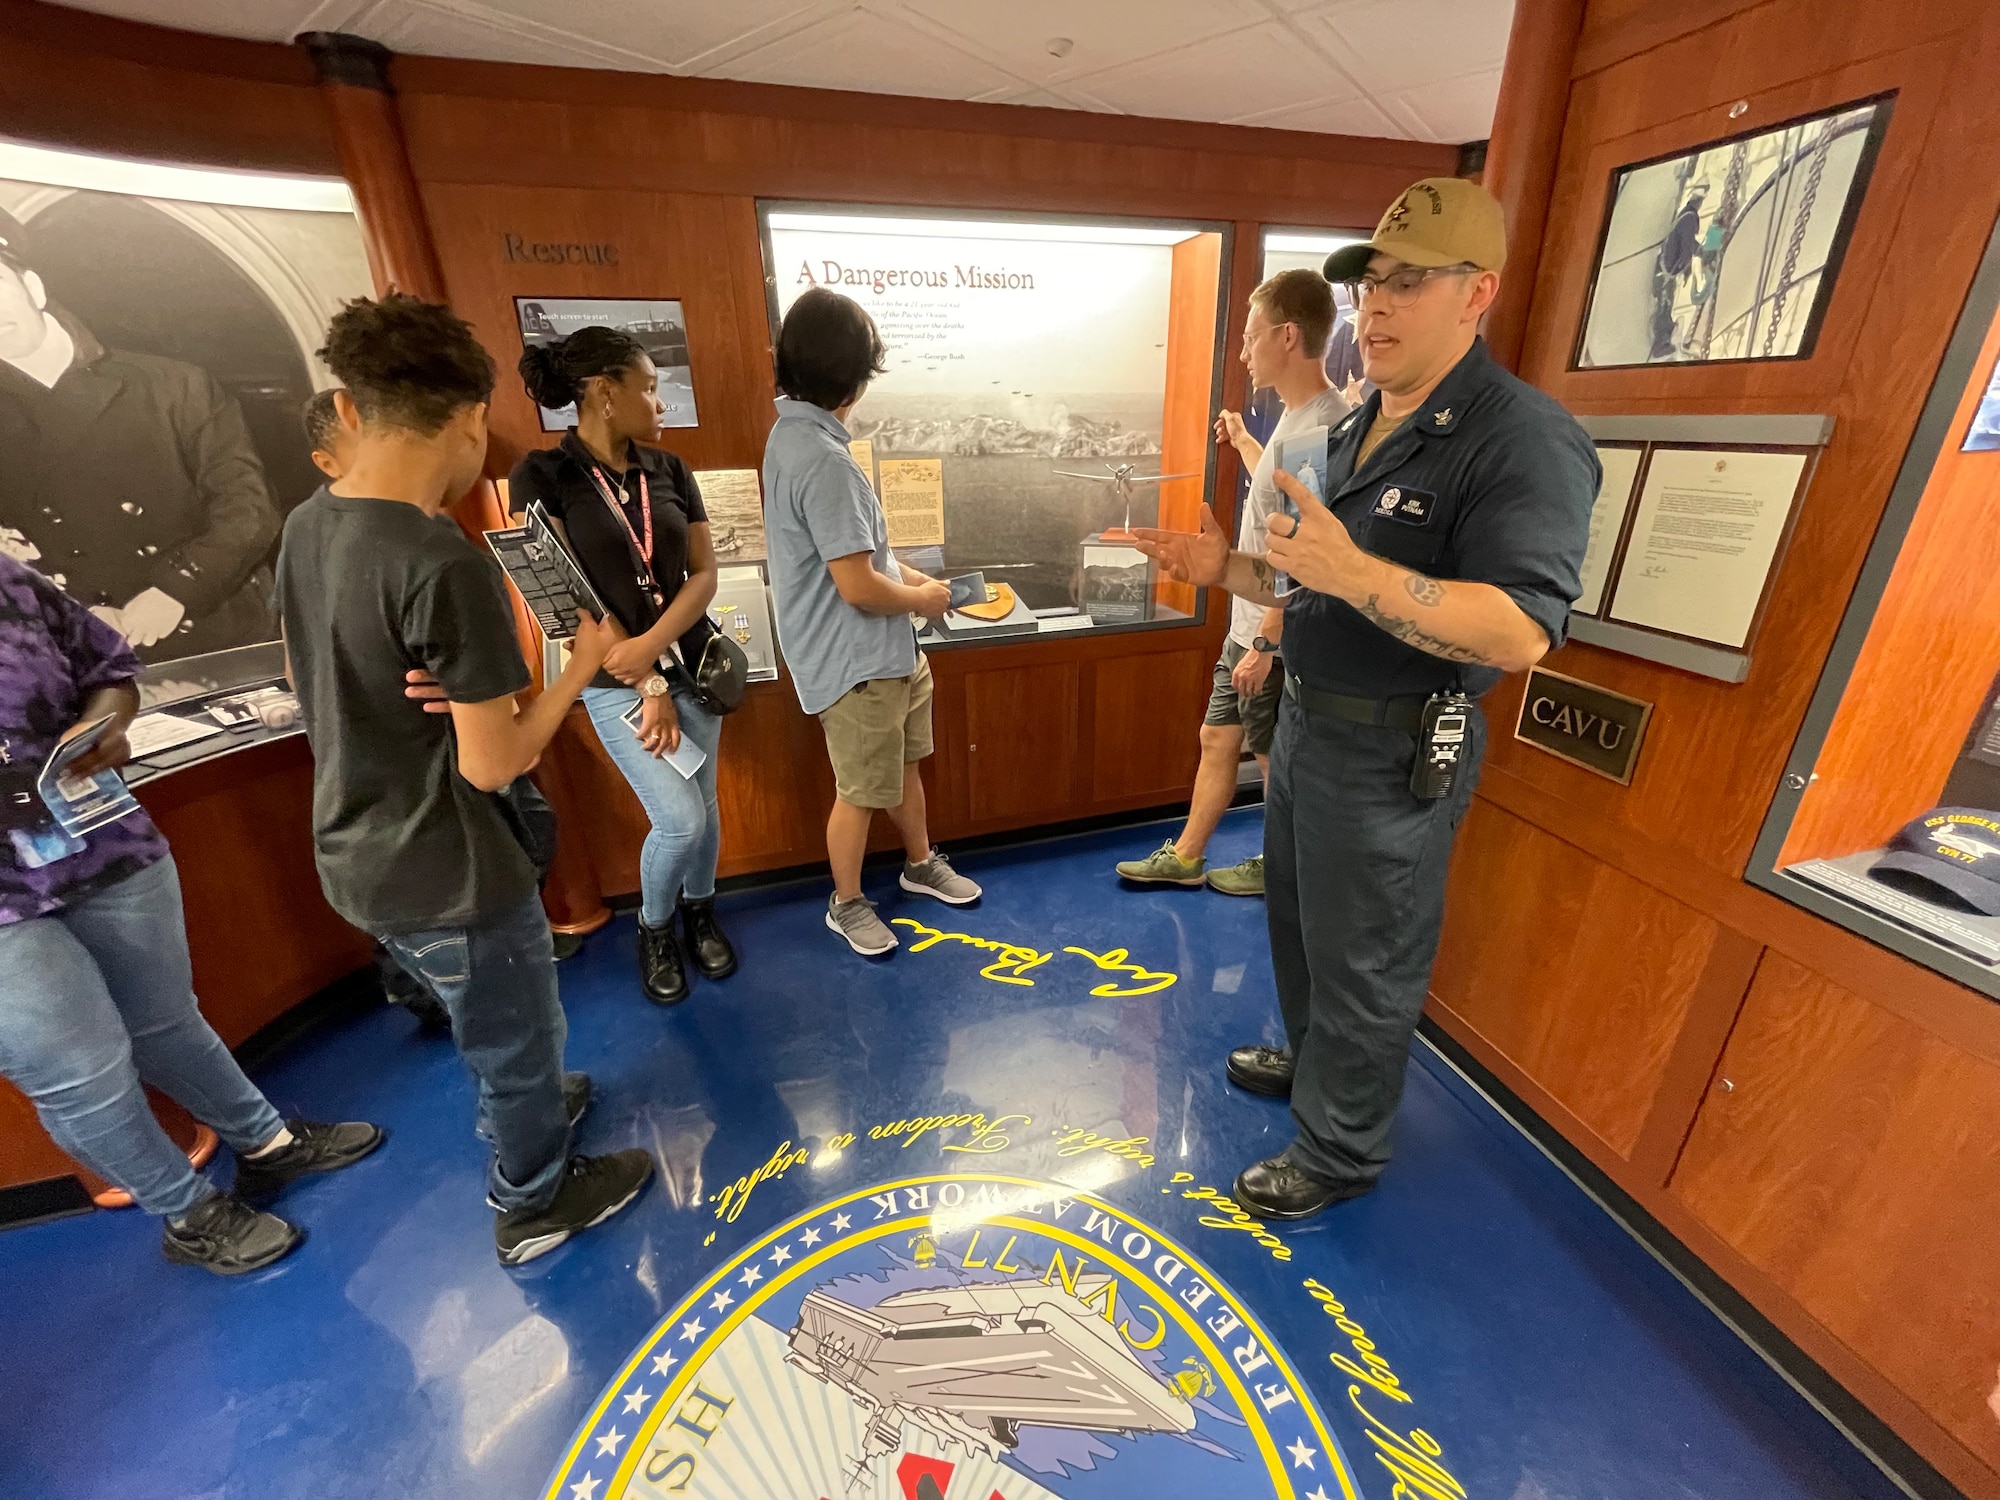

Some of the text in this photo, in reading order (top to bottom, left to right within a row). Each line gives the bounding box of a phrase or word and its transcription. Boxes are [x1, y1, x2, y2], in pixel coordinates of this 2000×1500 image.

[503, 233, 619, 266] Rescue
[796, 259, 1035, 294] A Dangerous Mission
[537, 312, 609, 321] Touch screen to start
[880, 310, 889, 320] of
[889, 310, 900, 318] the
[880, 323, 914, 331] agonizing
[926, 332, 935, 341] by
[1531, 696, 1627, 750] CAVU
[1924, 815, 1945, 828] USS
[1947, 814, 1990, 827] GEORGE
[1936, 845, 1977, 864] CVN 77
[868, 1112, 1033, 1155] Freedom
[869, 1183, 1005, 1221] WORK
[1161, 1171, 1293, 1262] what's
[961, 1228, 1167, 1351] CVN 77
[1080, 1204, 1296, 1415] FREEDOM
[1302, 1277, 1414, 1404] know
[645, 1381, 736, 1491] SH
